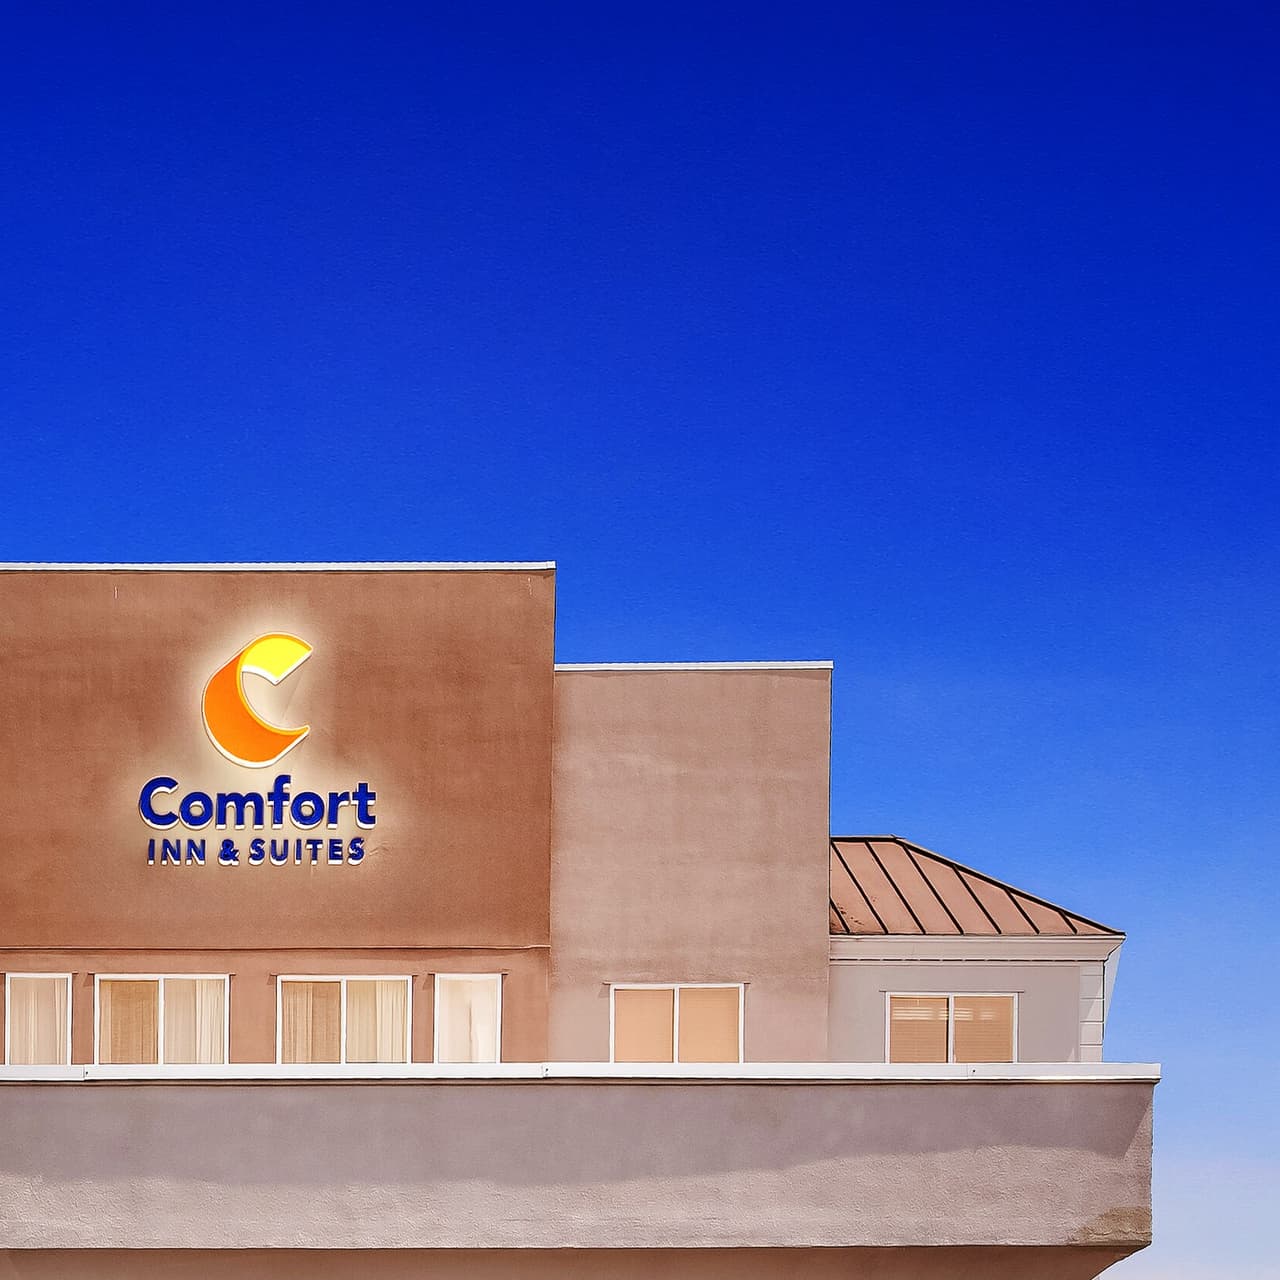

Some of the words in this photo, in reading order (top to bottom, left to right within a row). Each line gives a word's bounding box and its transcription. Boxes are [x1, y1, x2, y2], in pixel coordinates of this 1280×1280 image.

[139, 774, 377, 830] Comfort
[147, 838, 207, 866] INN
[217, 838, 240, 866] &
[248, 837, 366, 866] SUITES
